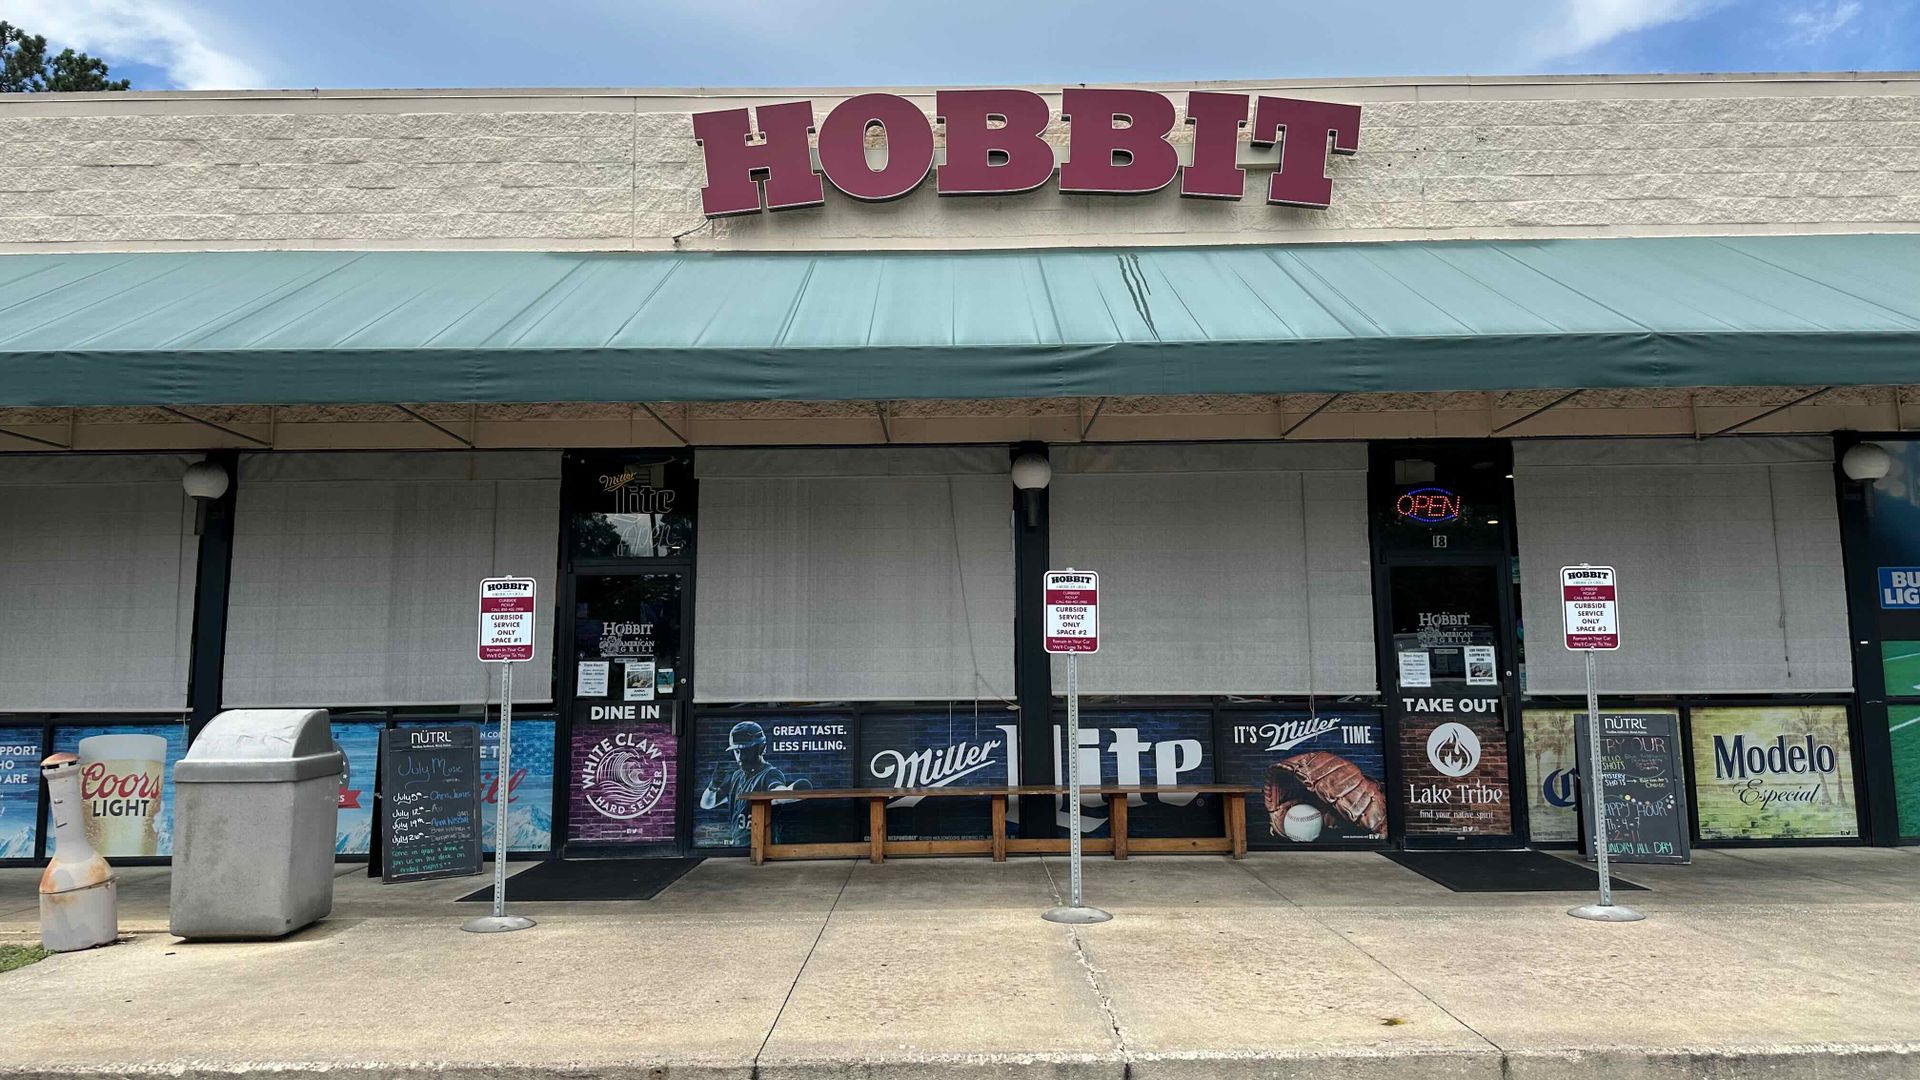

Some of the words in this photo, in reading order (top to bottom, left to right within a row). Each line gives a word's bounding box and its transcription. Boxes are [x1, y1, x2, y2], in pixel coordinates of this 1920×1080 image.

[692, 88, 1361, 218] HOBBIT
[1397, 494, 1460, 516] OPEN
[1051, 576, 1091, 584] HOBBIT
[1568, 571, 1608, 579] HOBBIT
[1892, 572, 1920, 588] BU
[488, 583, 529, 591] HOBBIT
[1884, 588, 1920, 604] LIG
[1419, 612, 1470, 626] HOBBIT
[602, 622, 653, 636] HOBBIT
[1402, 698, 1454, 712] TAKE
[1458, 698, 1498, 712] OUT
[591, 706, 636, 720] DINE
[641, 705, 660, 719] IN
[1604, 716, 1647, 729] NÜTRL
[411, 730, 452, 744] NÜTRL
[773, 726, 808, 736] GREAT
[811, 726, 847, 735] TASTE.
[1234, 726, 1258, 744] IT'S
[1259, 718, 1341, 751] Miller
[0, 746, 37, 755] PPORT
[773, 742, 800, 751] LESS
[802, 741, 846, 750] FILLING.
[582, 738, 614, 790] WHITE
[615, 733, 662, 760] CLAW
[1713, 735, 1836, 780] Modelo
[1602, 761, 1626, 770] SHOTS
[4, 774, 28, 784] ARE
[81, 763, 161, 800] Coors
[870, 740, 1000, 806] Miller
[996, 724, 1202, 833] Lite
[596, 796, 626, 814] HARD
[630, 770, 662, 813] SELTZER
[1410, 784, 1452, 804] Lake
[1456, 778, 1503, 804] Tribe
[1733, 778, 1821, 810] Especial
[393, 793, 412, 804] July
[92, 800, 150, 817] LIGHT
[392, 810, 409, 821] July
[1420, 810, 1433, 818] find
[1435, 812, 1450, 820] your
[1454, 810, 1474, 818] native
[1476, 810, 1493, 820] spirit
[1604, 802, 1630, 817] APPY
[1636, 801, 1668, 816] HOUR
[392, 822, 408, 834] July
[392, 835, 408, 846] July
[1606, 842, 1634, 854] UNDAY
[1637, 843, 1652, 854] ALL
[1654, 842, 1672, 854] DAY
